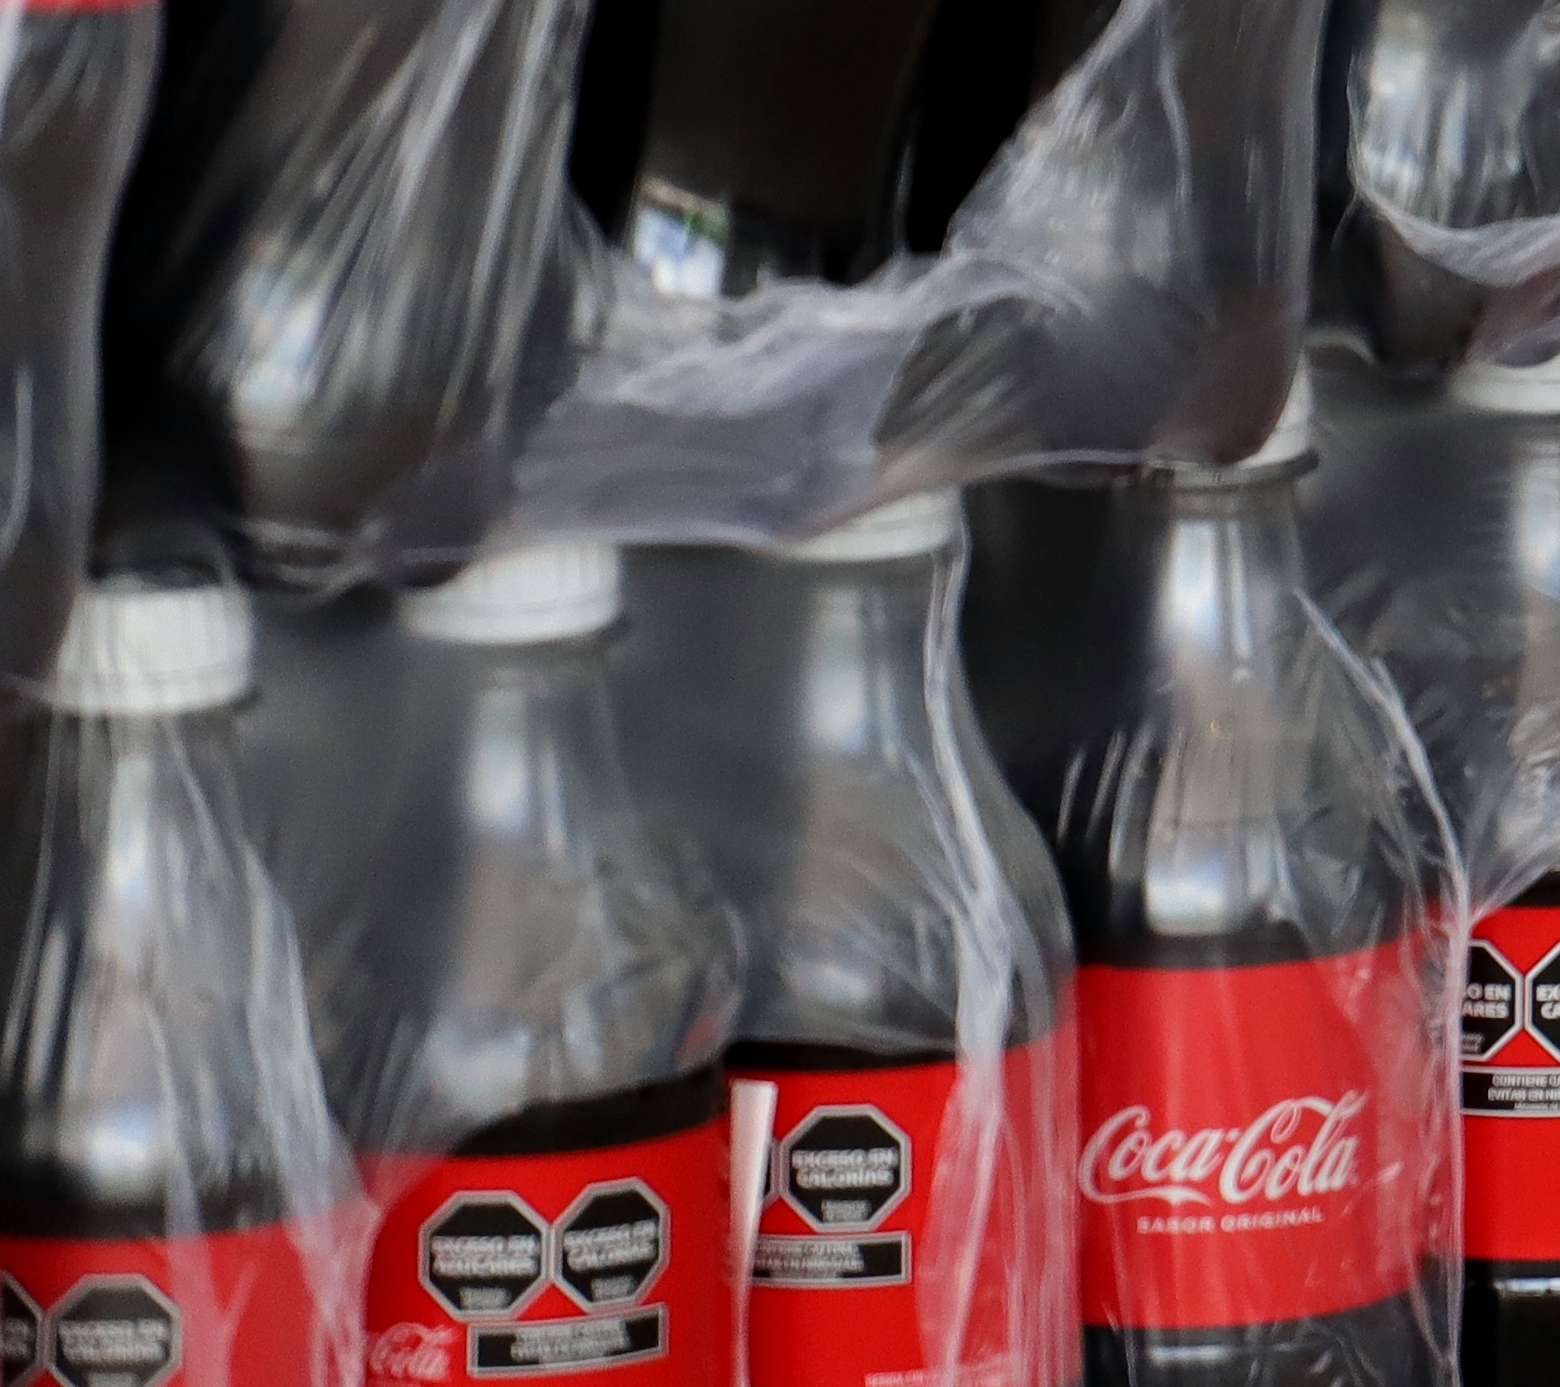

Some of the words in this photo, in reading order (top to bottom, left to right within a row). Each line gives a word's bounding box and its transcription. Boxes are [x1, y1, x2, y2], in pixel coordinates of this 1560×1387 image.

[1484, 983, 1512, 1000] EN
[1078, 1088, 1367, 1207] Coca-Cola
[1137, 1215, 1214, 1234] SABOR
[1220, 1204, 1326, 1233] ORIGINAL
